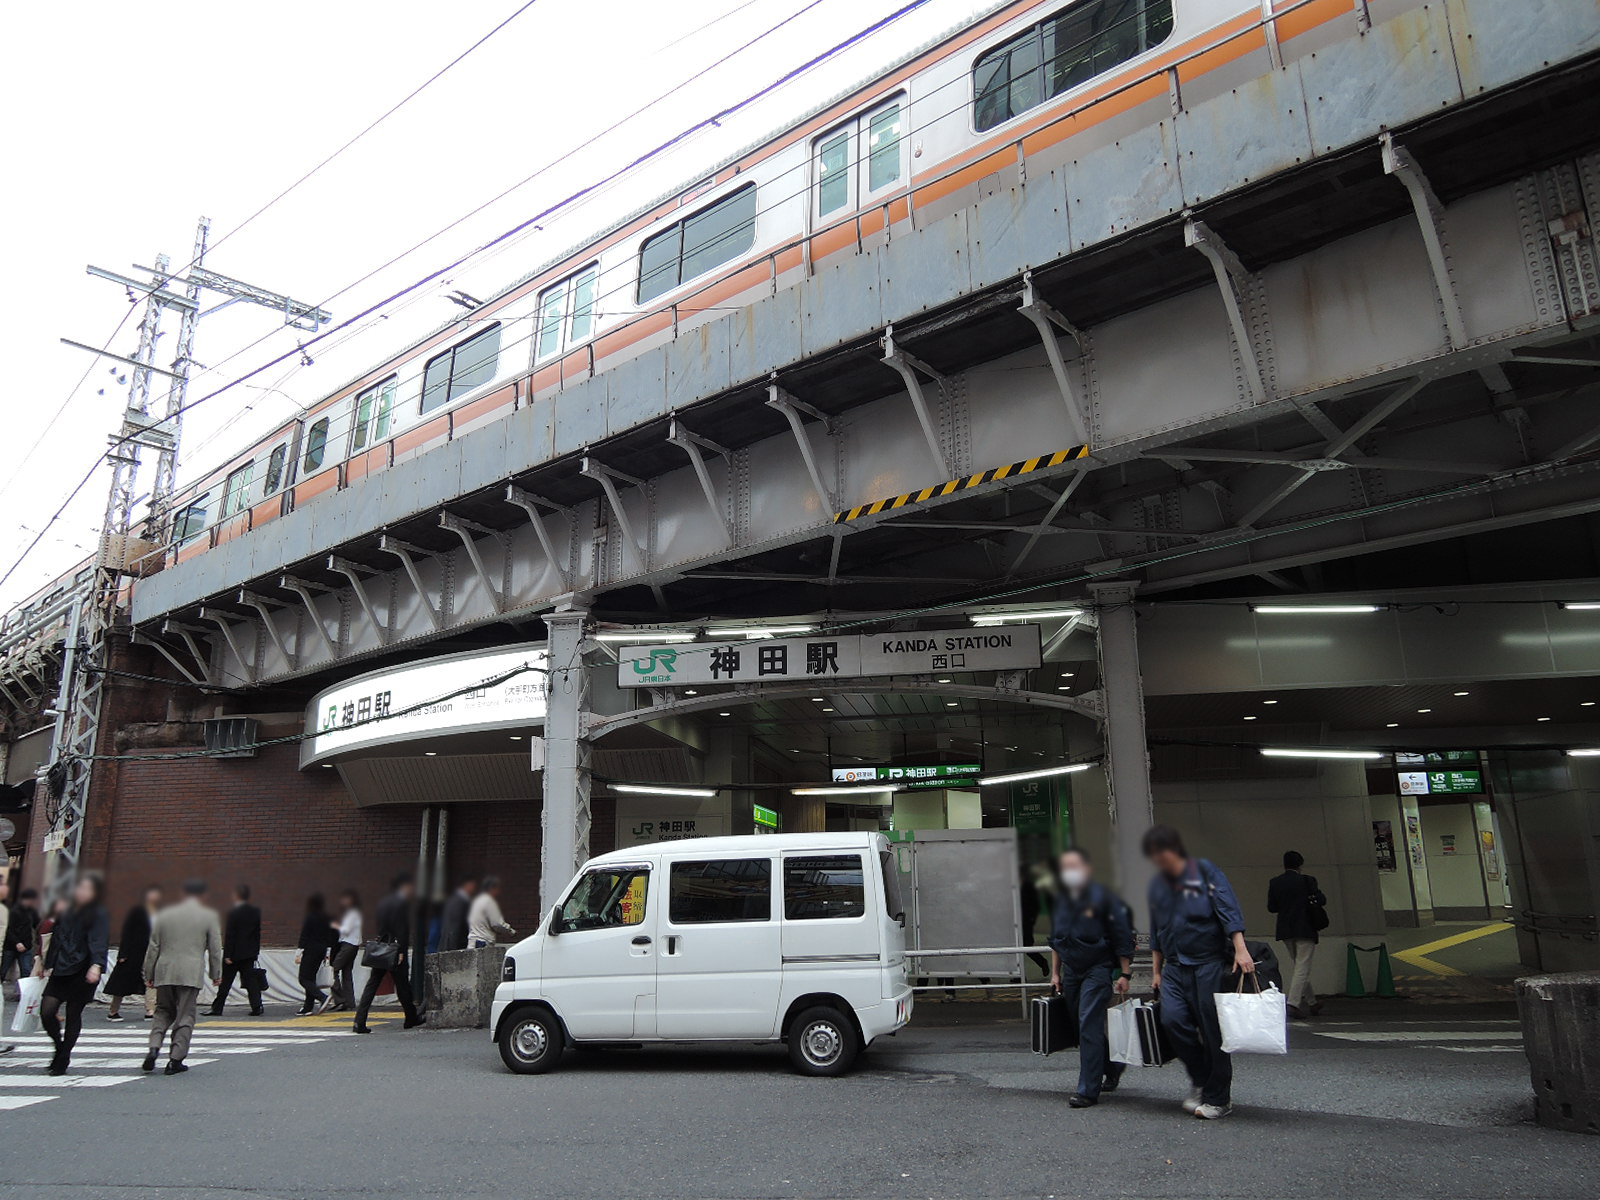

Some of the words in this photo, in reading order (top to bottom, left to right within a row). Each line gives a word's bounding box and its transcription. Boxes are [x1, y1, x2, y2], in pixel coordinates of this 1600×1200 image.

[882, 638, 938, 654] KANDA
[945, 634, 1012, 651] STATION
[633, 648, 677, 675] JR
[709, 641, 840, 680] 神田駅
[931, 653, 966, 670] 西口
[323, 704, 337, 731] JR
[342, 690, 391, 727] 神田駅
[905, 767, 937, 779] 神田駅
[632, 822, 653, 835] JR
[659, 820, 696, 833] 神田駅
